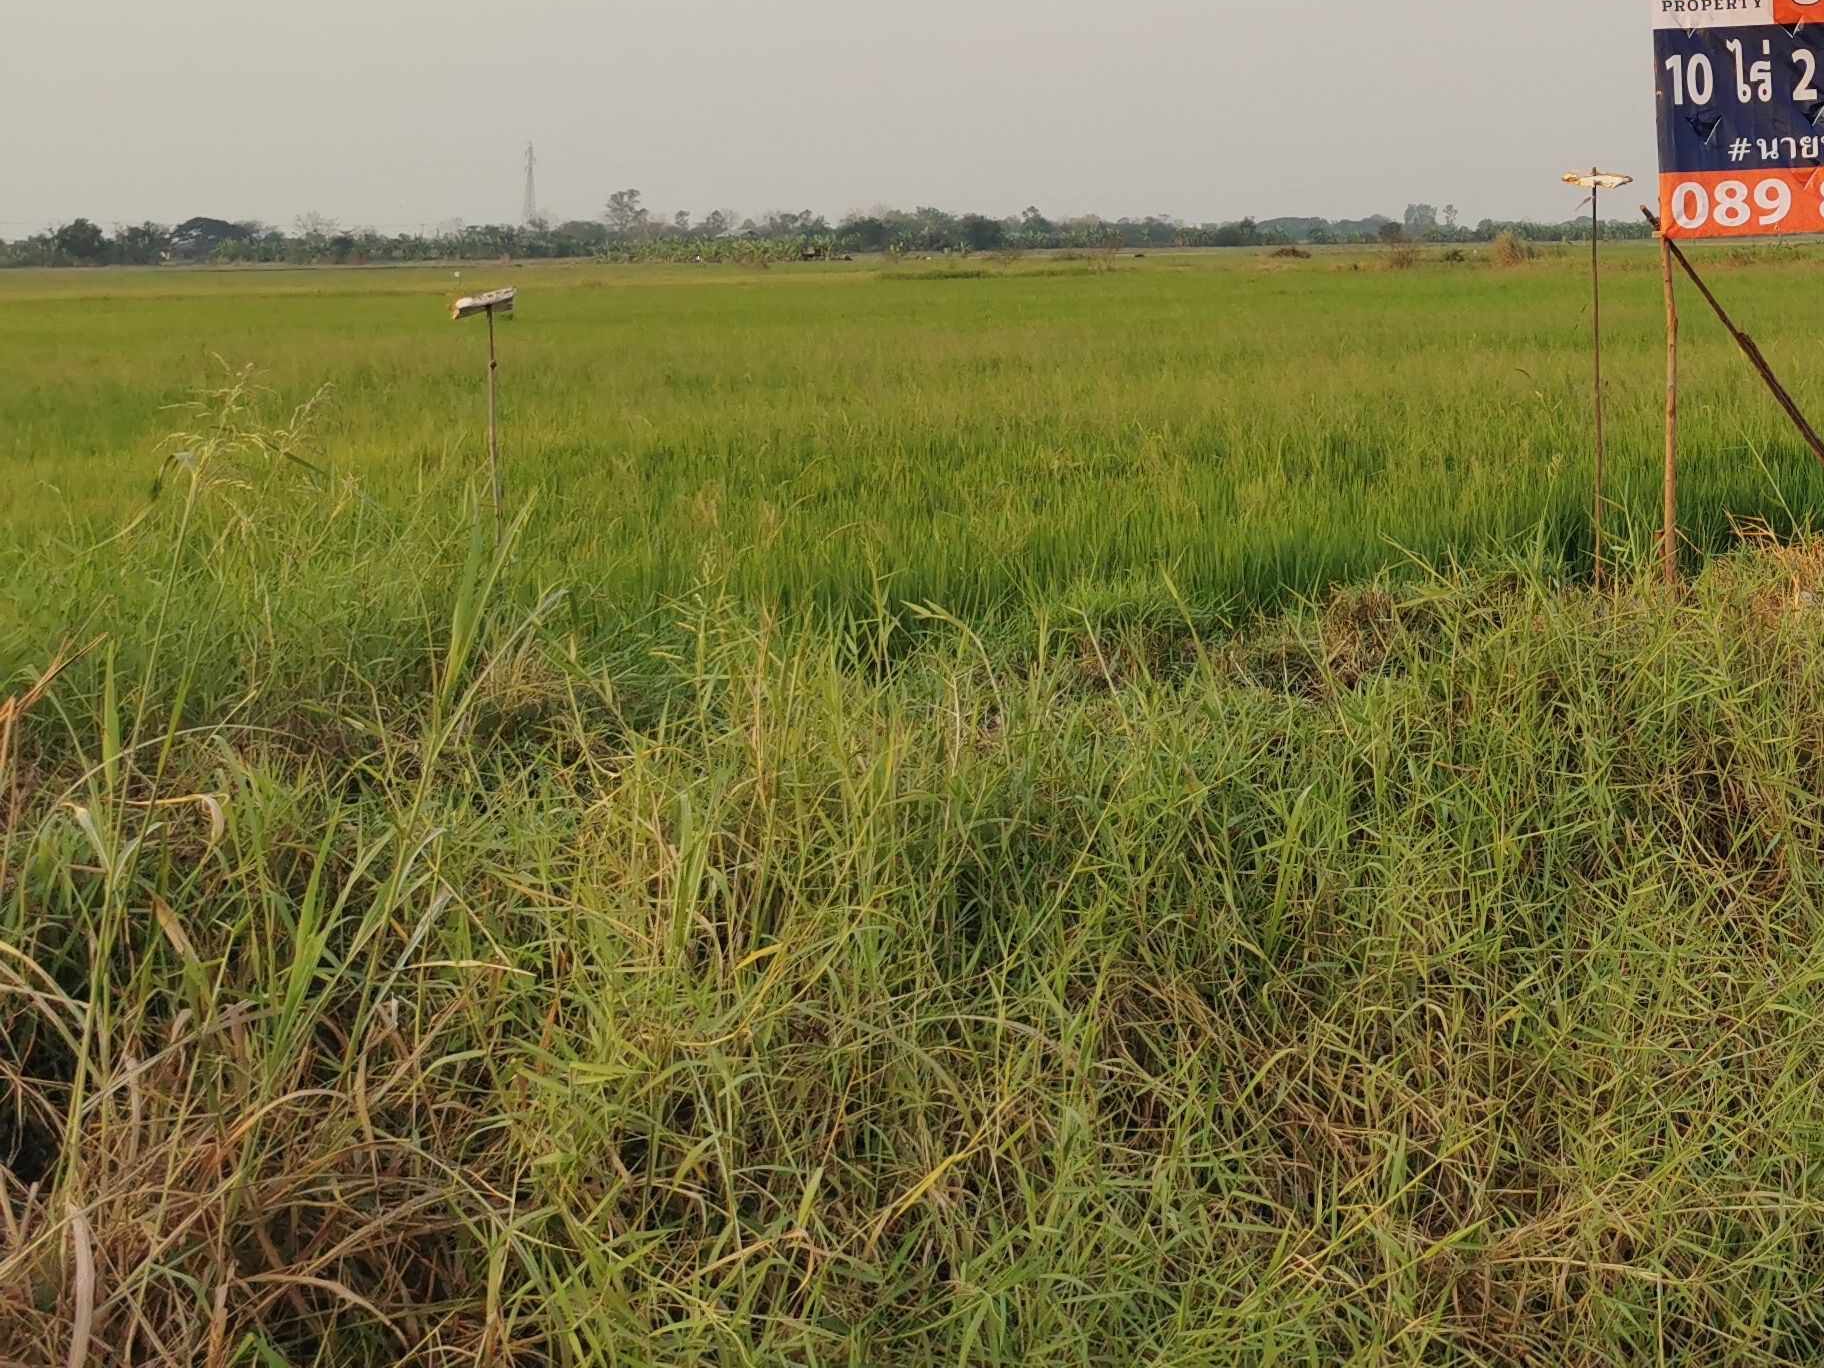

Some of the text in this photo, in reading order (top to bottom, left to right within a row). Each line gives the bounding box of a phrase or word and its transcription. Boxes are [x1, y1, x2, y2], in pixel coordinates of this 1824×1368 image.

[1665, 53, 1714, 105] 10
[1726, 39, 1772, 103] ไร่
[1793, 49, 1817, 100] 2
[1671, 178, 1791, 228] 089
